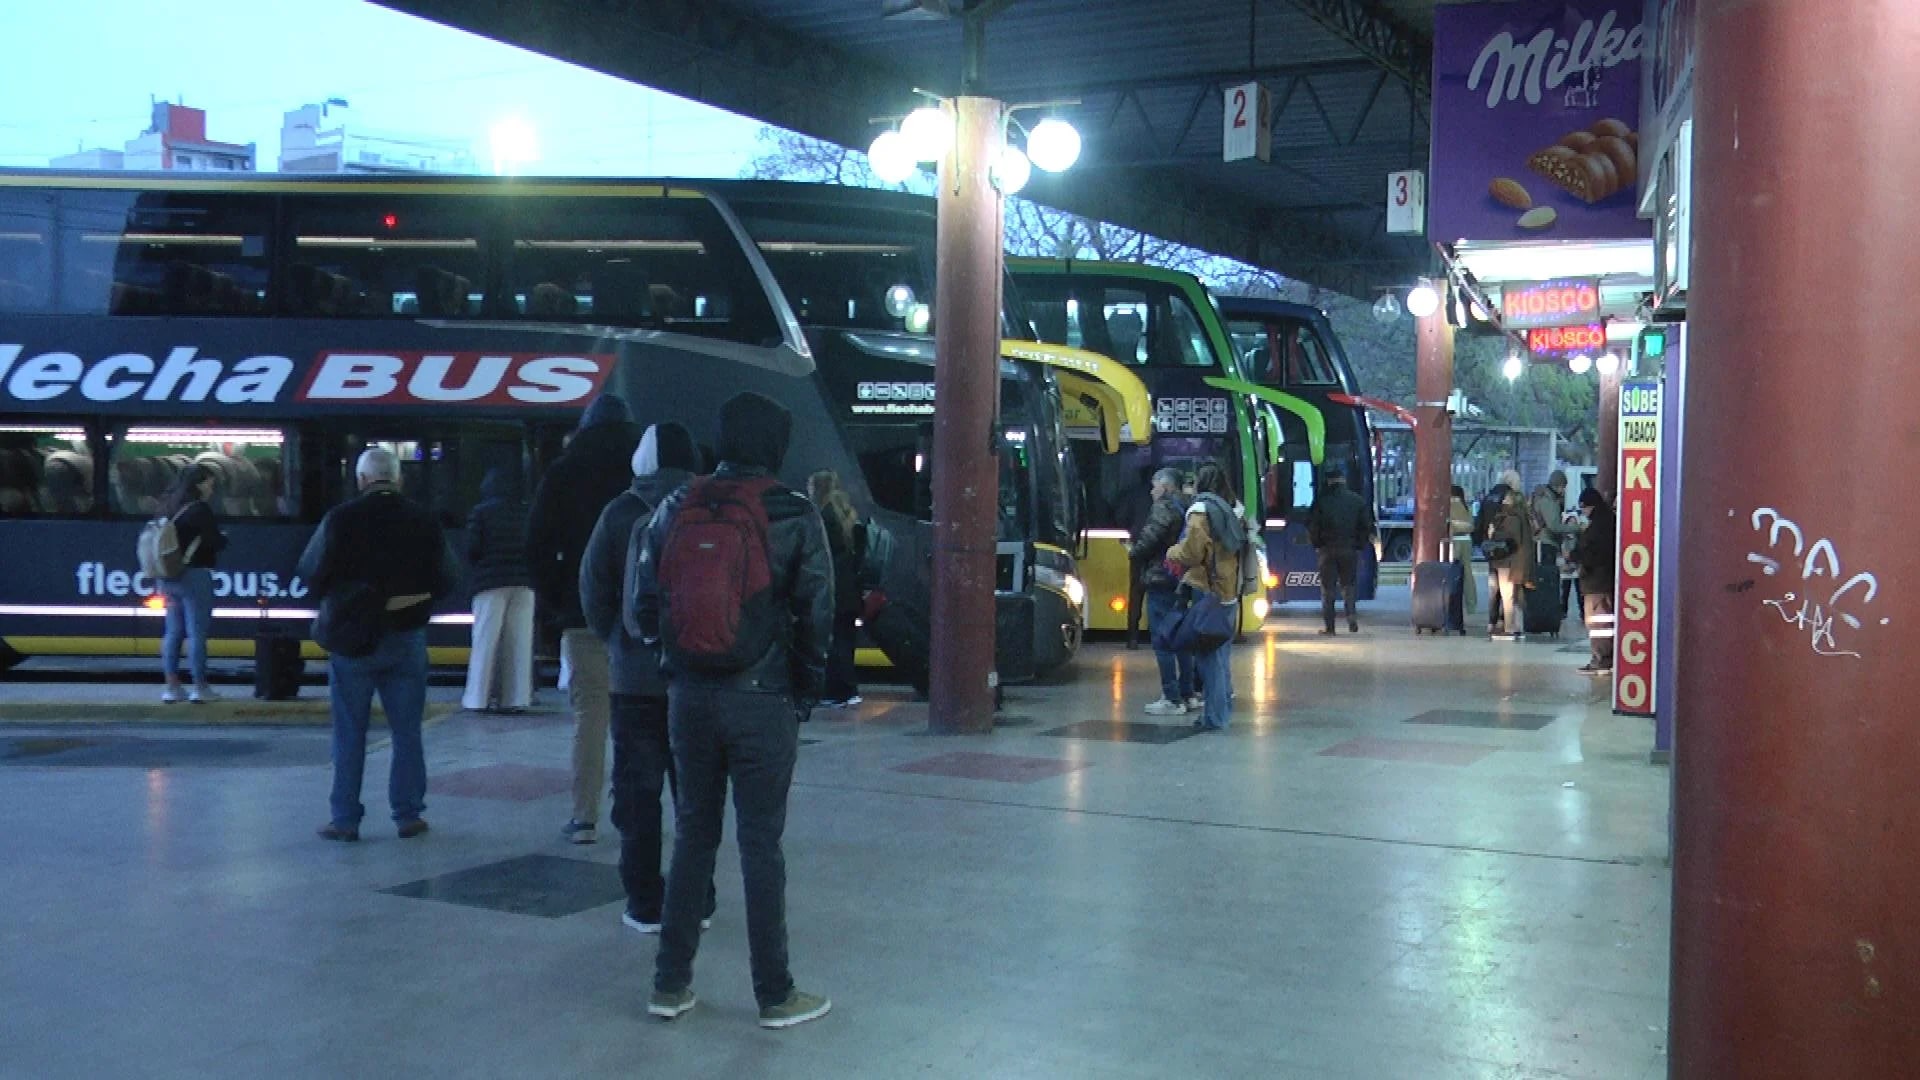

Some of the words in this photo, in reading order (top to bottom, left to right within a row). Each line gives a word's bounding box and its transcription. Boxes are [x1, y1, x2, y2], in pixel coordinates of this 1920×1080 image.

[1233, 89, 1246, 128] 2
[1395, 175, 1408, 207] 3
[1505, 287, 1596, 316] KIOSCO
[1531, 330, 1604, 349] KIOSCO
[306, 355, 600, 401] BUS
[1624, 421, 1656, 442] TABACO
[1618, 457, 1653, 708] KIOSCO
